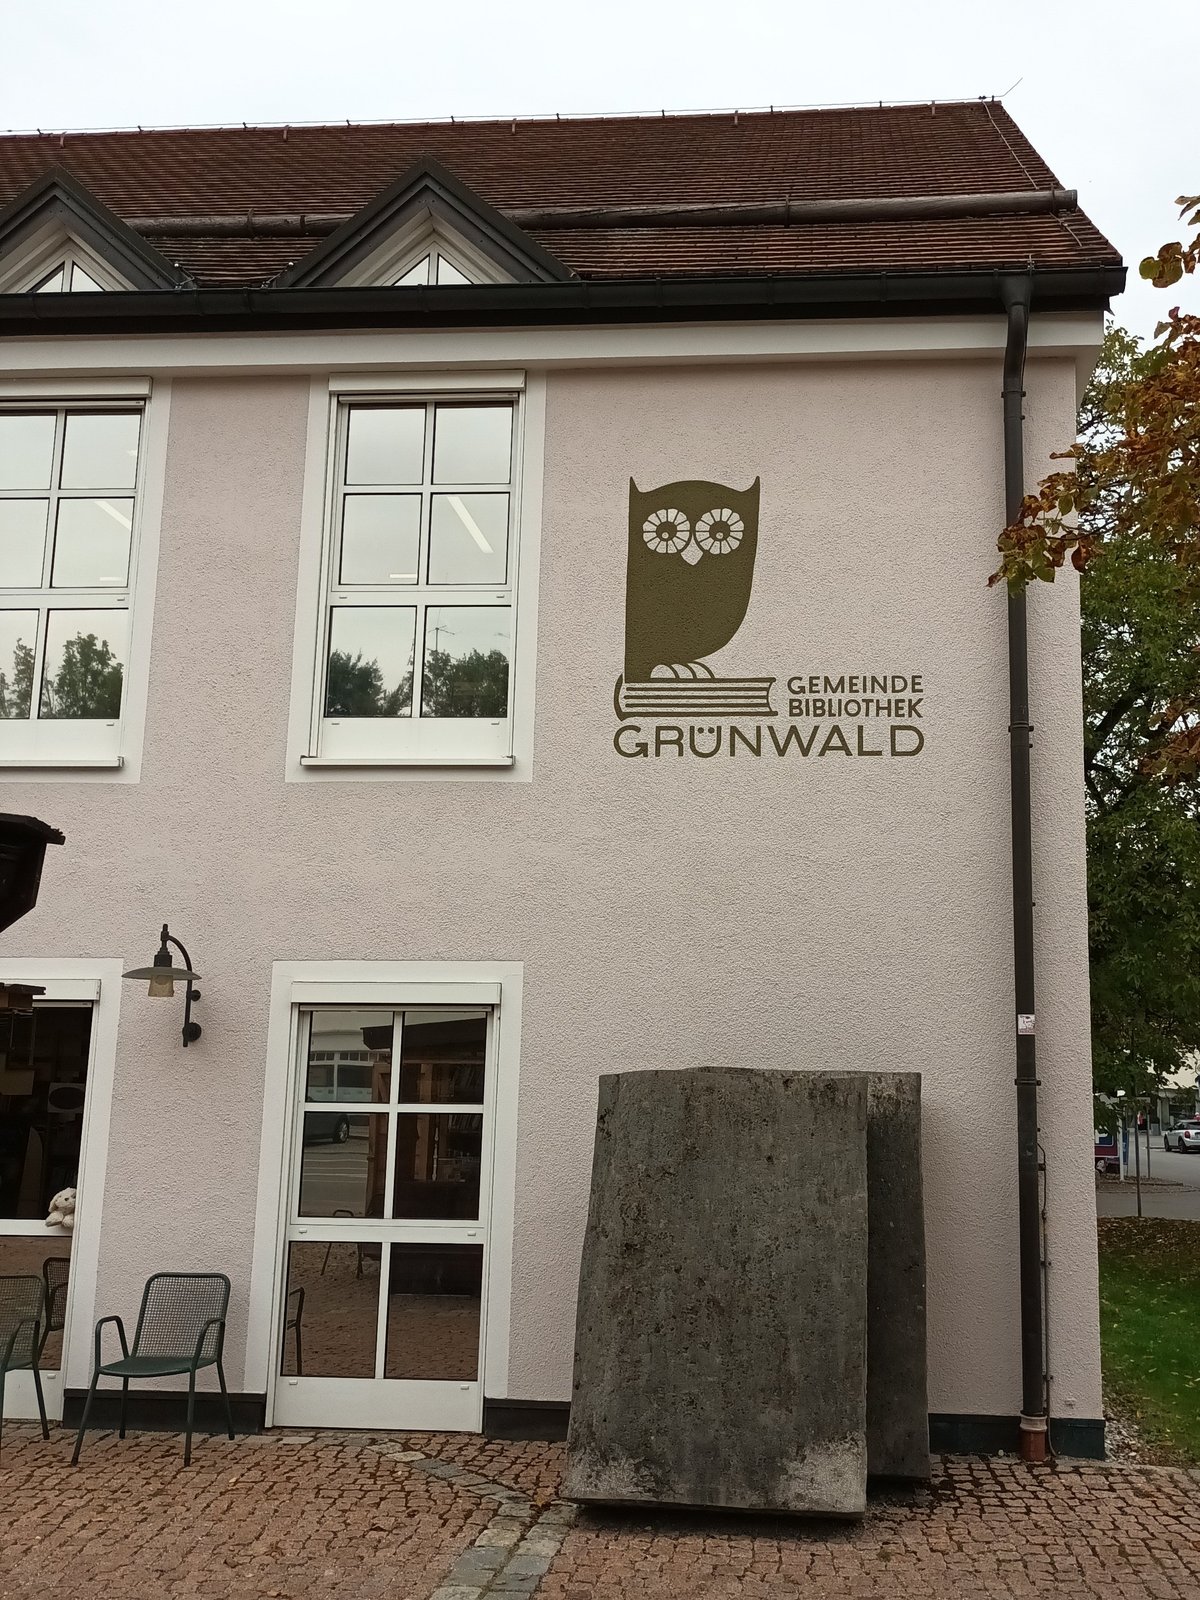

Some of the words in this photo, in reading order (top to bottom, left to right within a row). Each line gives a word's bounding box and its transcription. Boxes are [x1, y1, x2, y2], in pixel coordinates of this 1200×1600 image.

[787, 675, 924, 694] GEMEINDE
[788, 698, 924, 718] BIBLIOTHEK
[613, 724, 925, 758] GRÜNWALD
